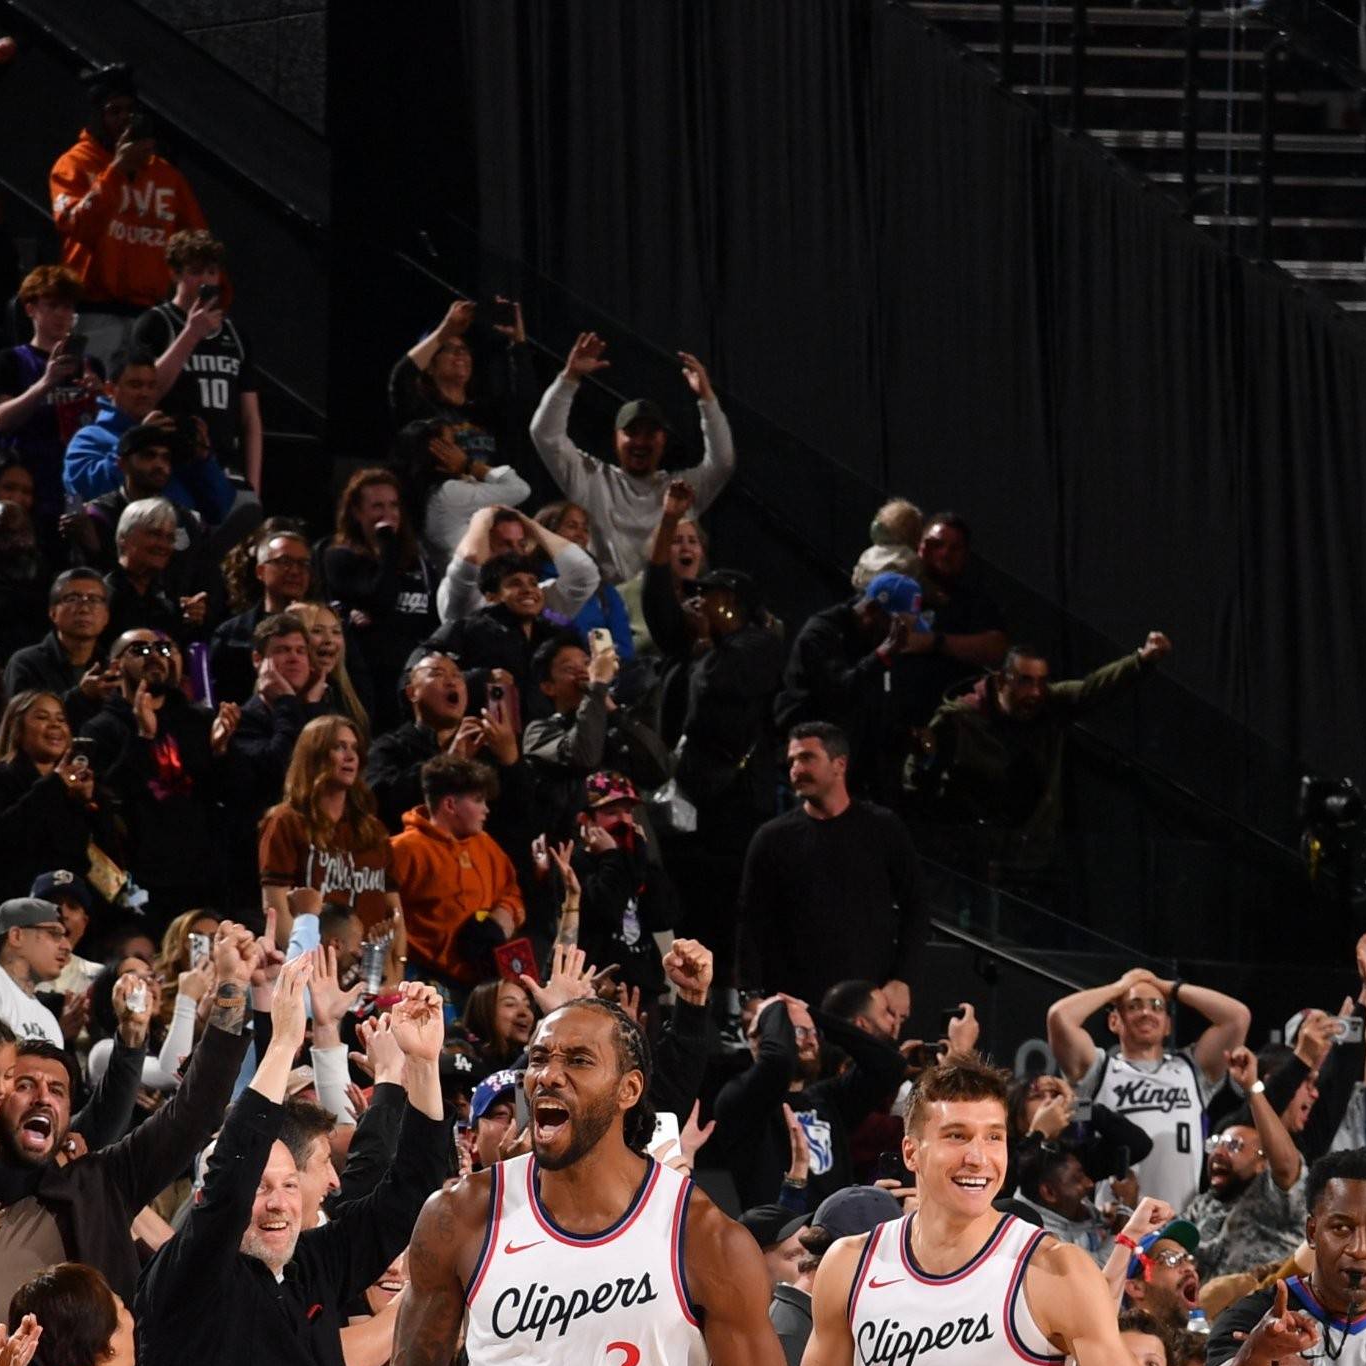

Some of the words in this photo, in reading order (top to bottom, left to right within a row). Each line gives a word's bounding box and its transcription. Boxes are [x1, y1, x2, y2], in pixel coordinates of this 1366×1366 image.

[197, 377, 229, 410] 10
[453, 1053, 473, 1072] LA
[1113, 1080, 1192, 1114] Kings
[1176, 1122, 1191, 1154] 0
[492, 1272, 658, 1342] Clippers
